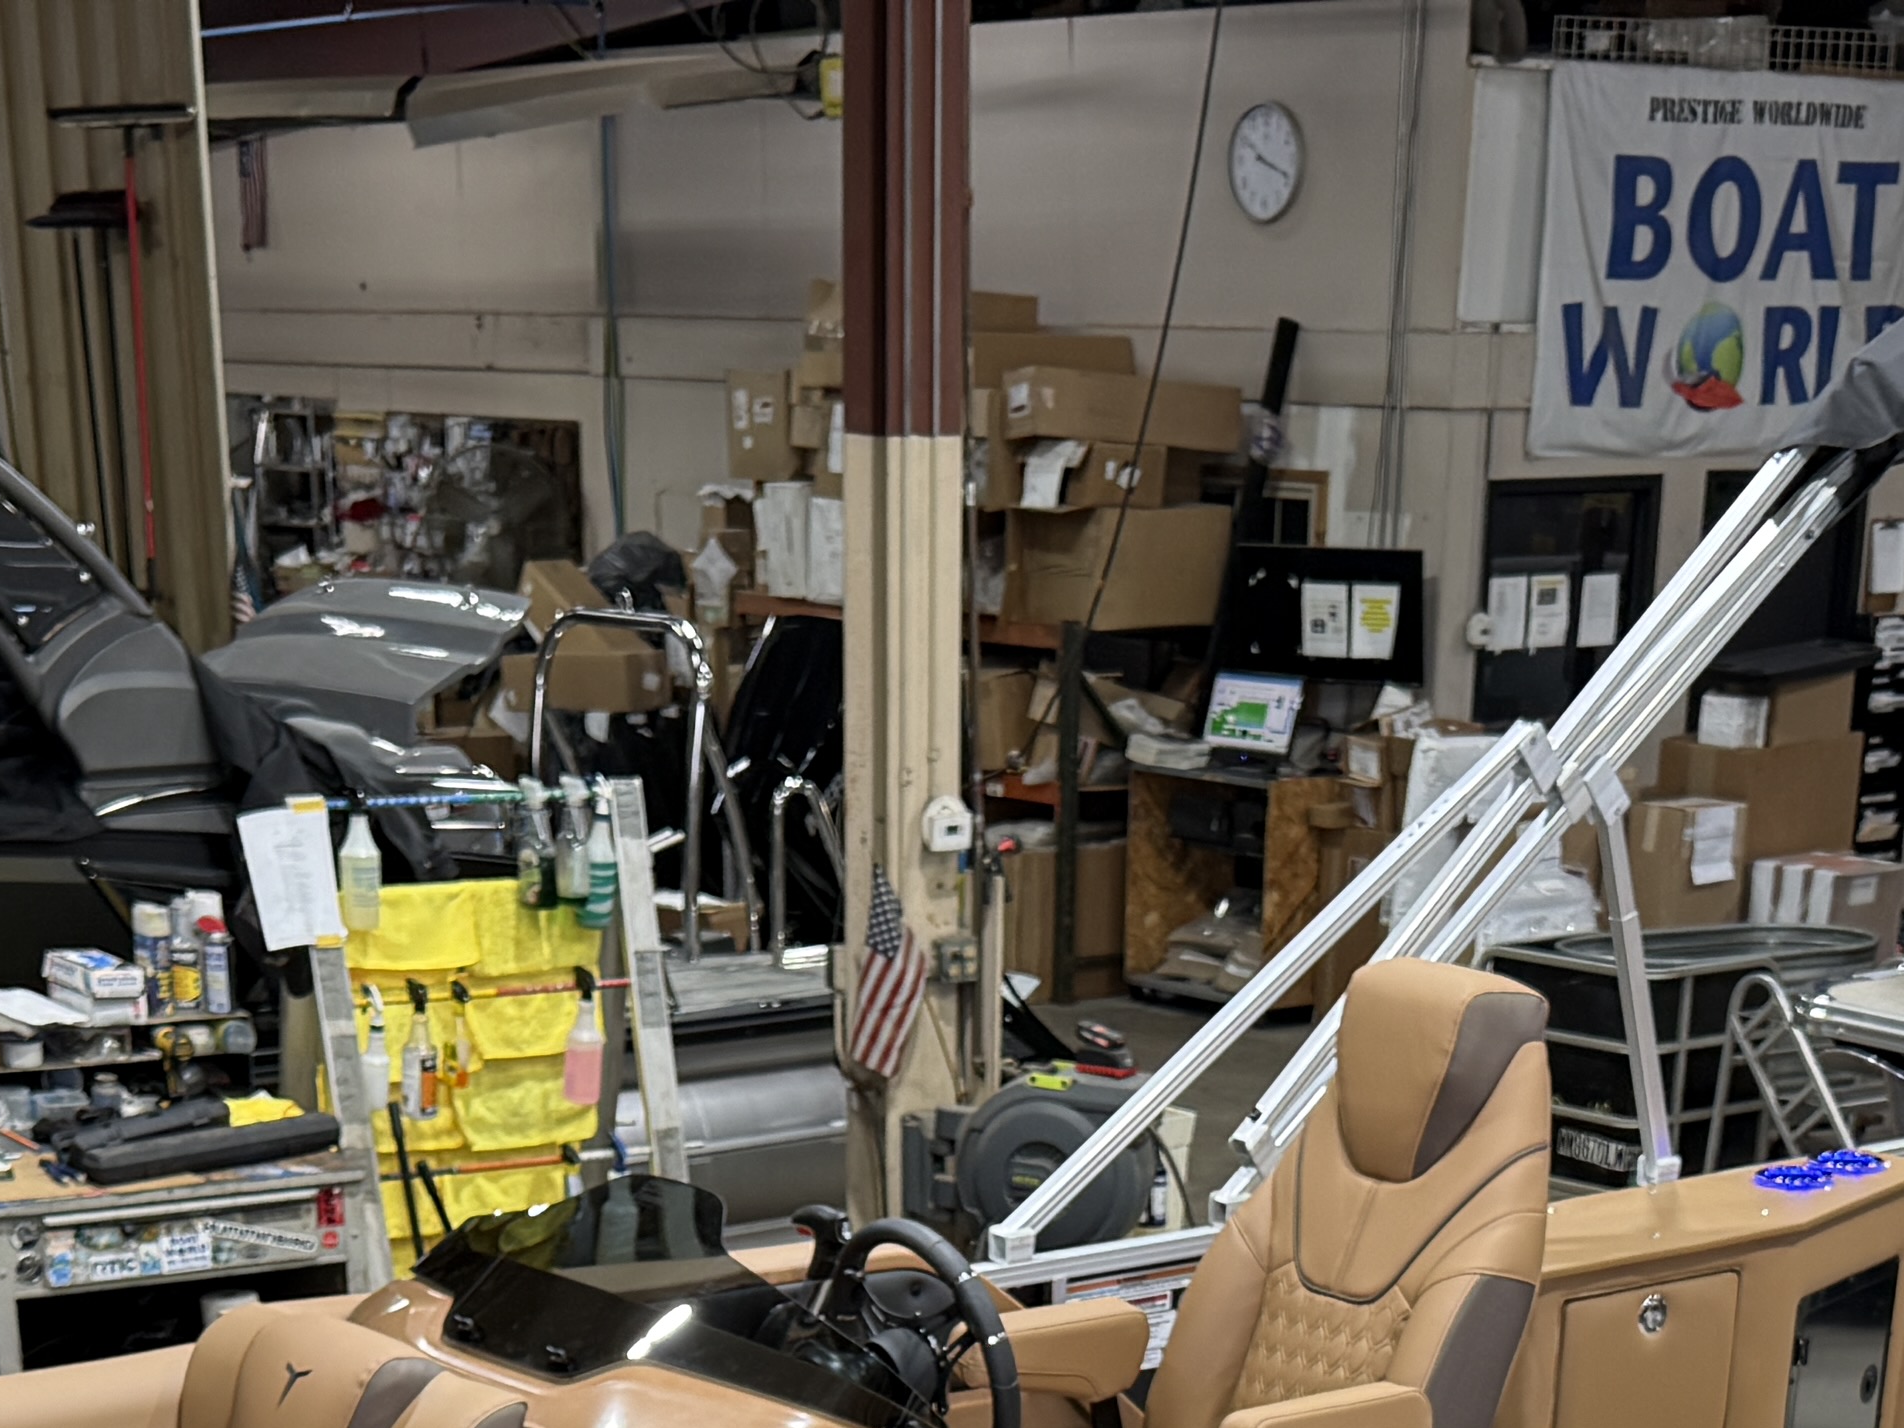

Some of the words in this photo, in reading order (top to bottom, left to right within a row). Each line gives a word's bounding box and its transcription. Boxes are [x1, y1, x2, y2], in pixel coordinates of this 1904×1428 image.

[1649, 97, 1744, 124] PRESTIGE
[1753, 100, 1866, 129] WORLDWIDE
[1606, 154, 1900, 283] BOAT
